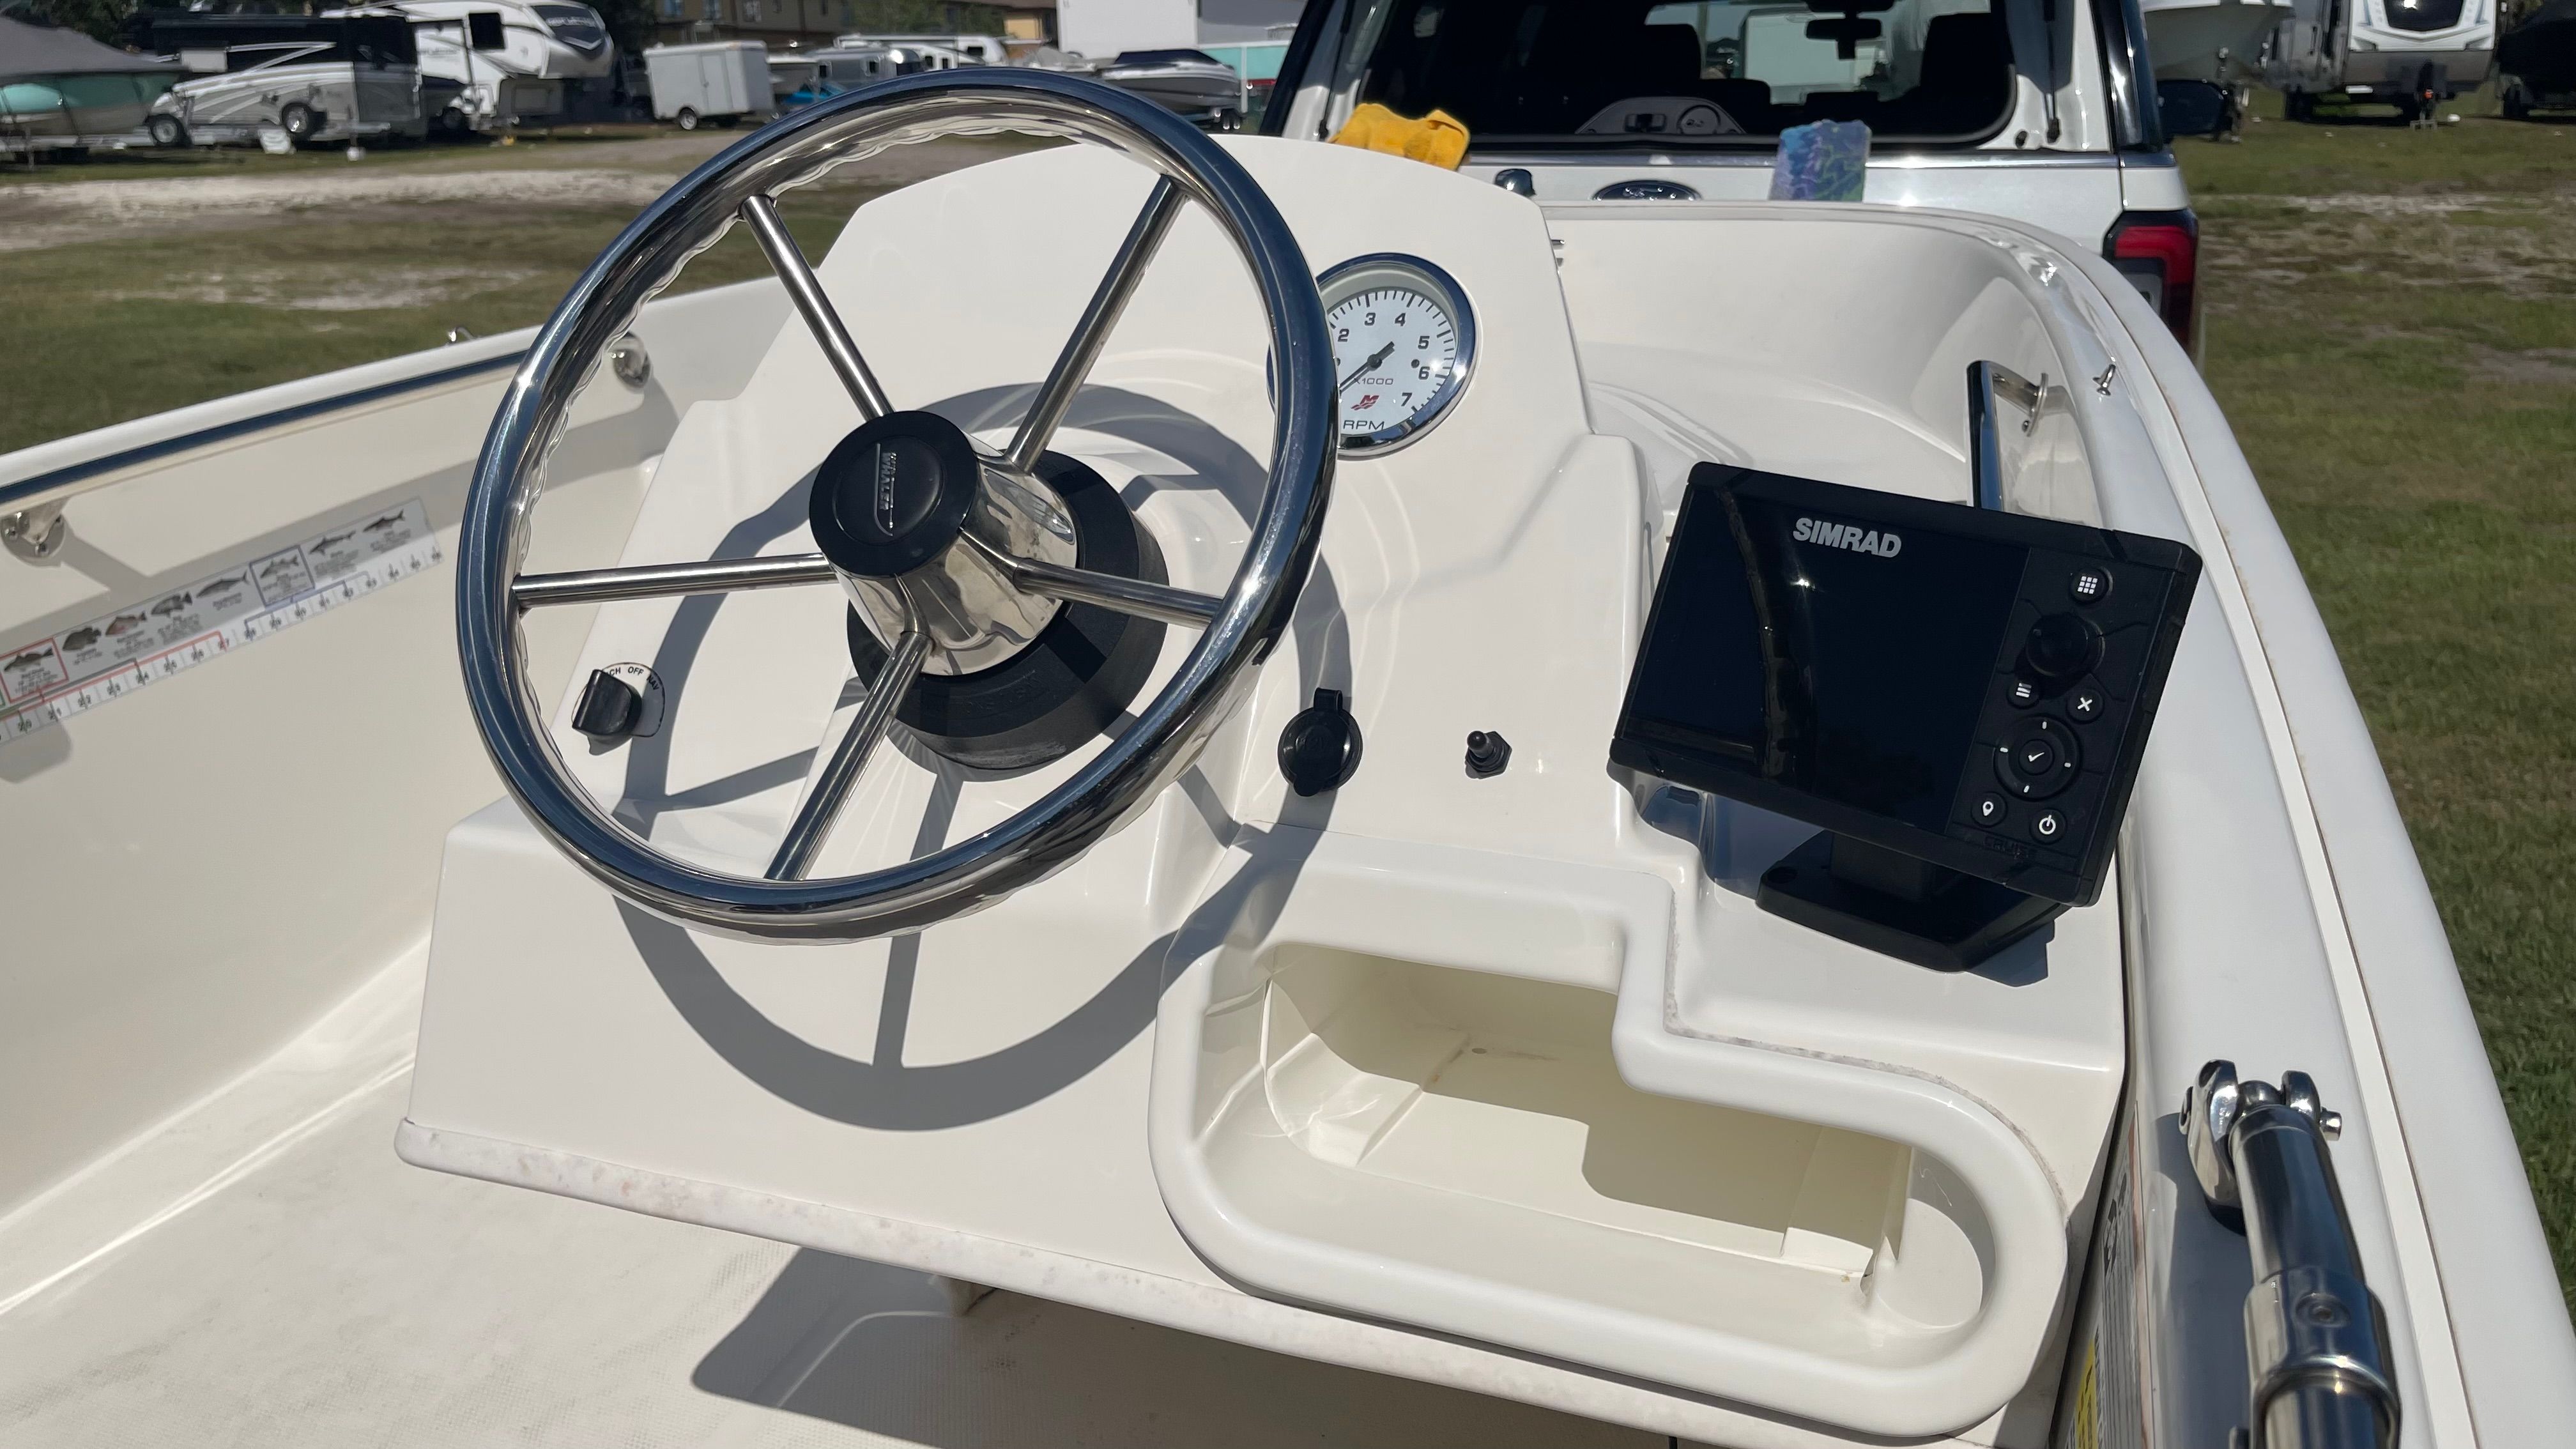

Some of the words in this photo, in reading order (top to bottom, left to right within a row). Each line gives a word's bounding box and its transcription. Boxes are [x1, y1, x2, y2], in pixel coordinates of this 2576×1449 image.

[1365, 312, 1376, 326] 3
[1395, 313, 1406, 326] 4
[1338, 328, 1349, 342] 2
[1418, 336, 1430, 349] 5
[1418, 367, 1430, 379] 6
[1401, 392, 1413, 406] 7
[1342, 419, 1386, 431] RPM
[1792, 517, 1903, 558] SIMRAD
[627, 666, 644, 675] OFF
[647, 675, 659, 690] NAV
